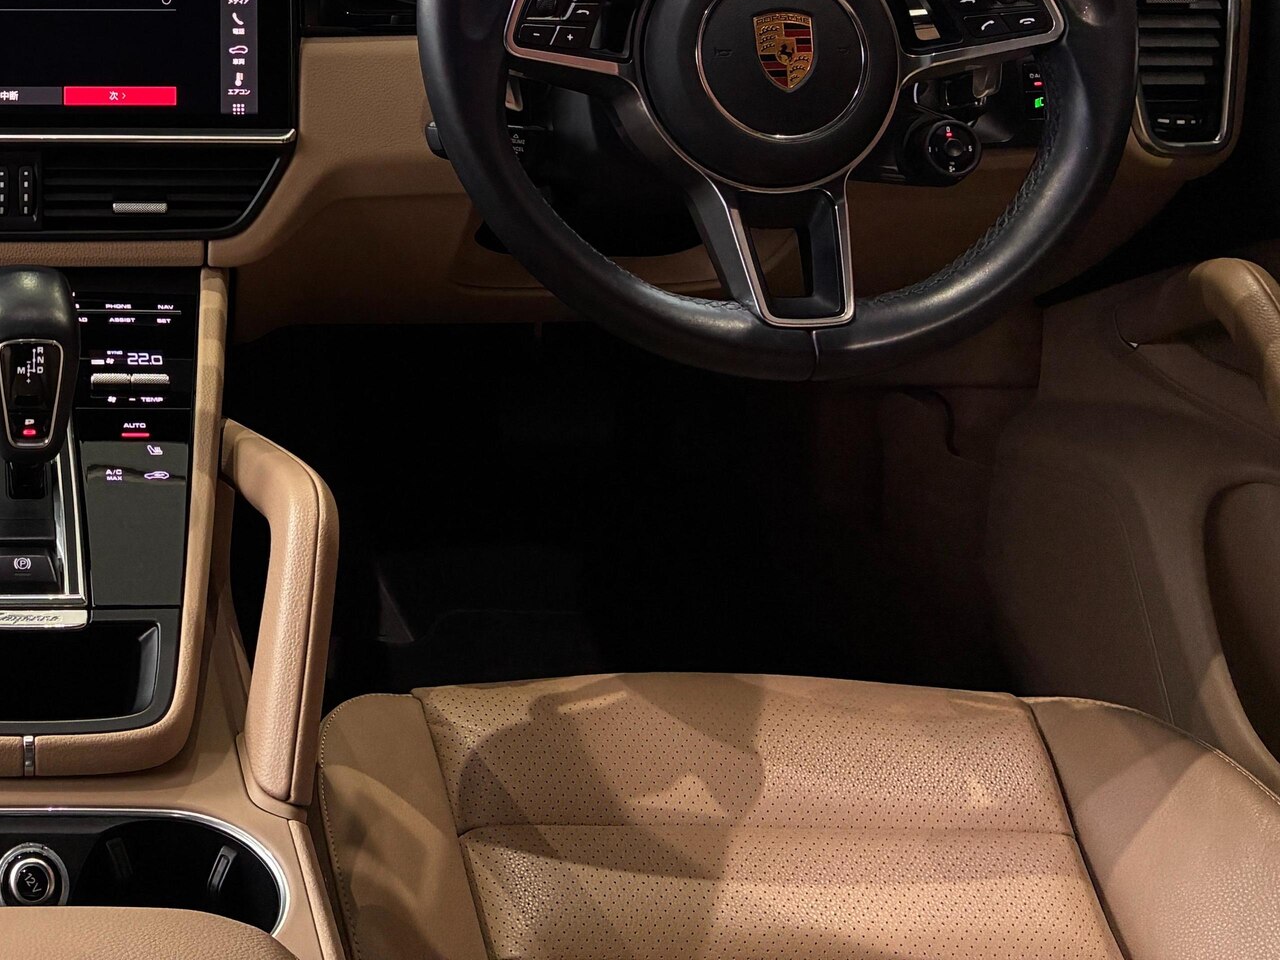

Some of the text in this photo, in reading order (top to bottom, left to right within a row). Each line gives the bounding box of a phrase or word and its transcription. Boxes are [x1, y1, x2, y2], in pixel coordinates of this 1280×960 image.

[756, 15, 810, 24] PORSCHE
[0, 91, 19, 101] 中断
[109, 91, 118, 100] 次
[127, 353, 163, 365] 22.0
